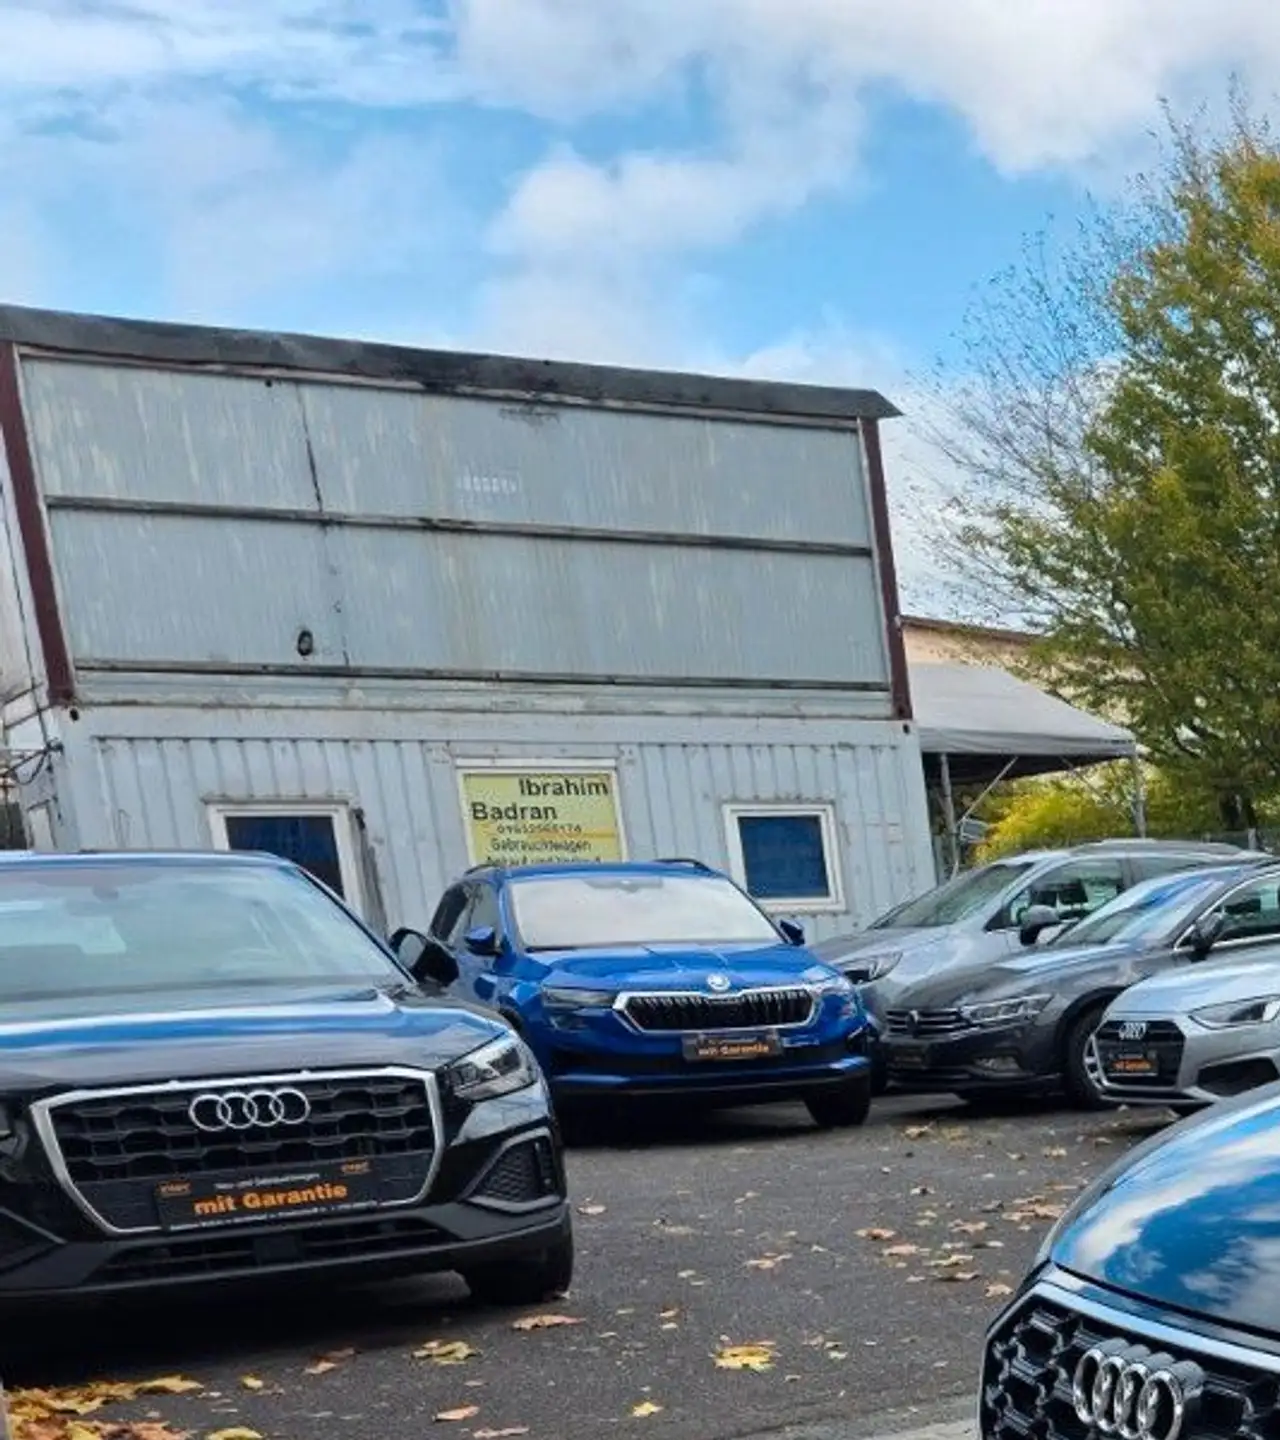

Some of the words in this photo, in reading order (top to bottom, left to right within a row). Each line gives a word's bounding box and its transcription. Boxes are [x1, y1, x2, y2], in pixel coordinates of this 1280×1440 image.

[518, 777, 609, 796] Ibrahim
[471, 801, 558, 821] Badran
[194, 1194, 237, 1216] mit
[241, 1183, 348, 1210] Garantie
